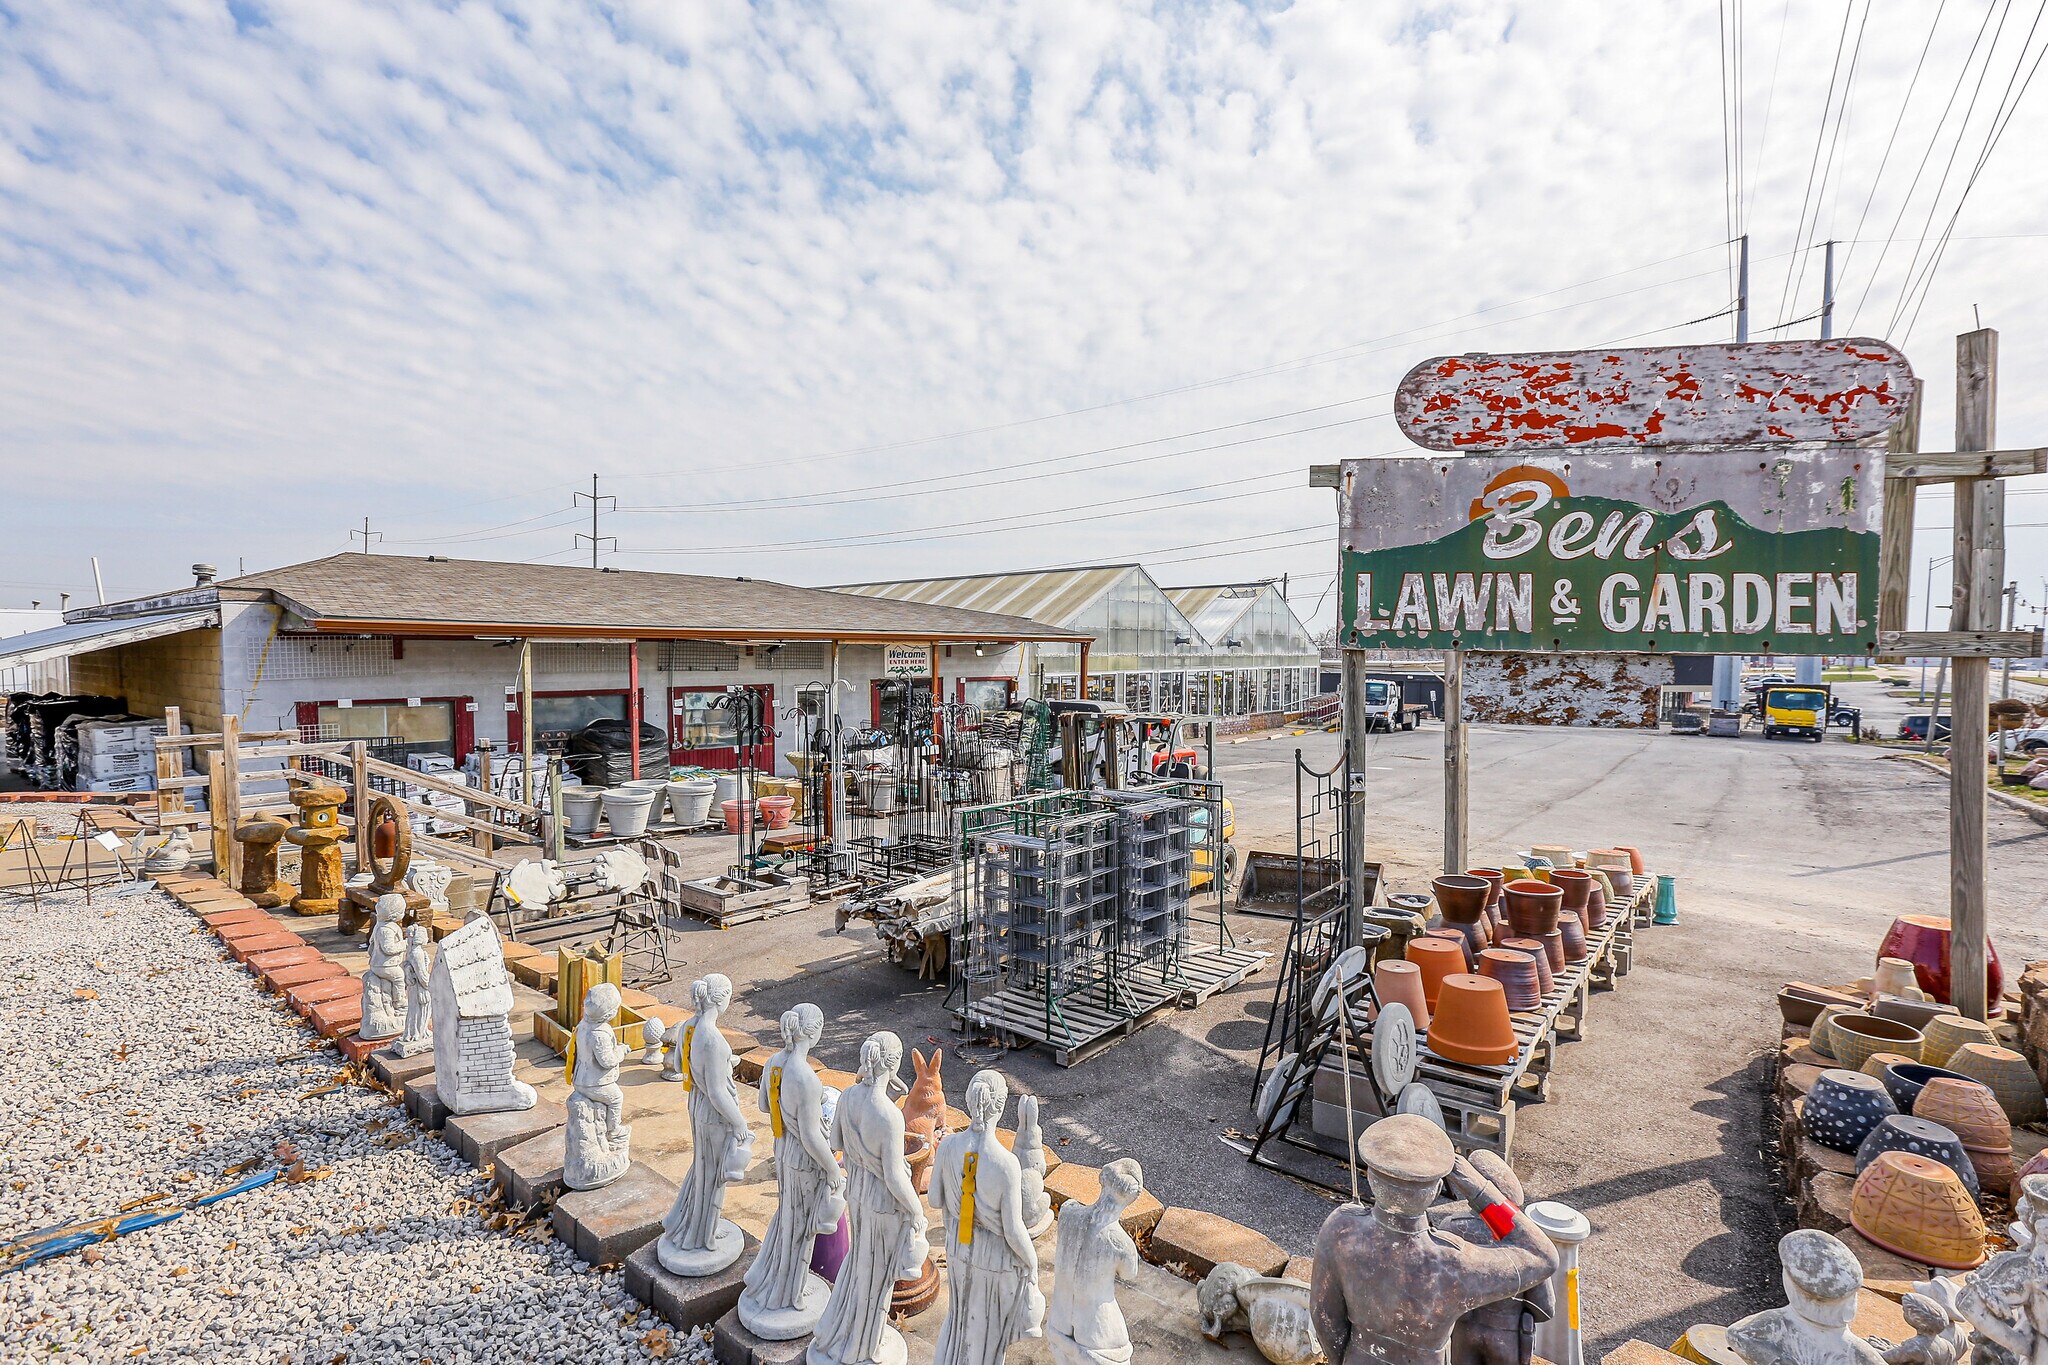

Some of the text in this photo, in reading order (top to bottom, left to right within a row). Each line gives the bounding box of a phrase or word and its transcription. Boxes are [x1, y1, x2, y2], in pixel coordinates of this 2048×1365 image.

[1356, 572, 1859, 634] LAWN & GARDEN
[889, 650, 926, 658] Welcome
